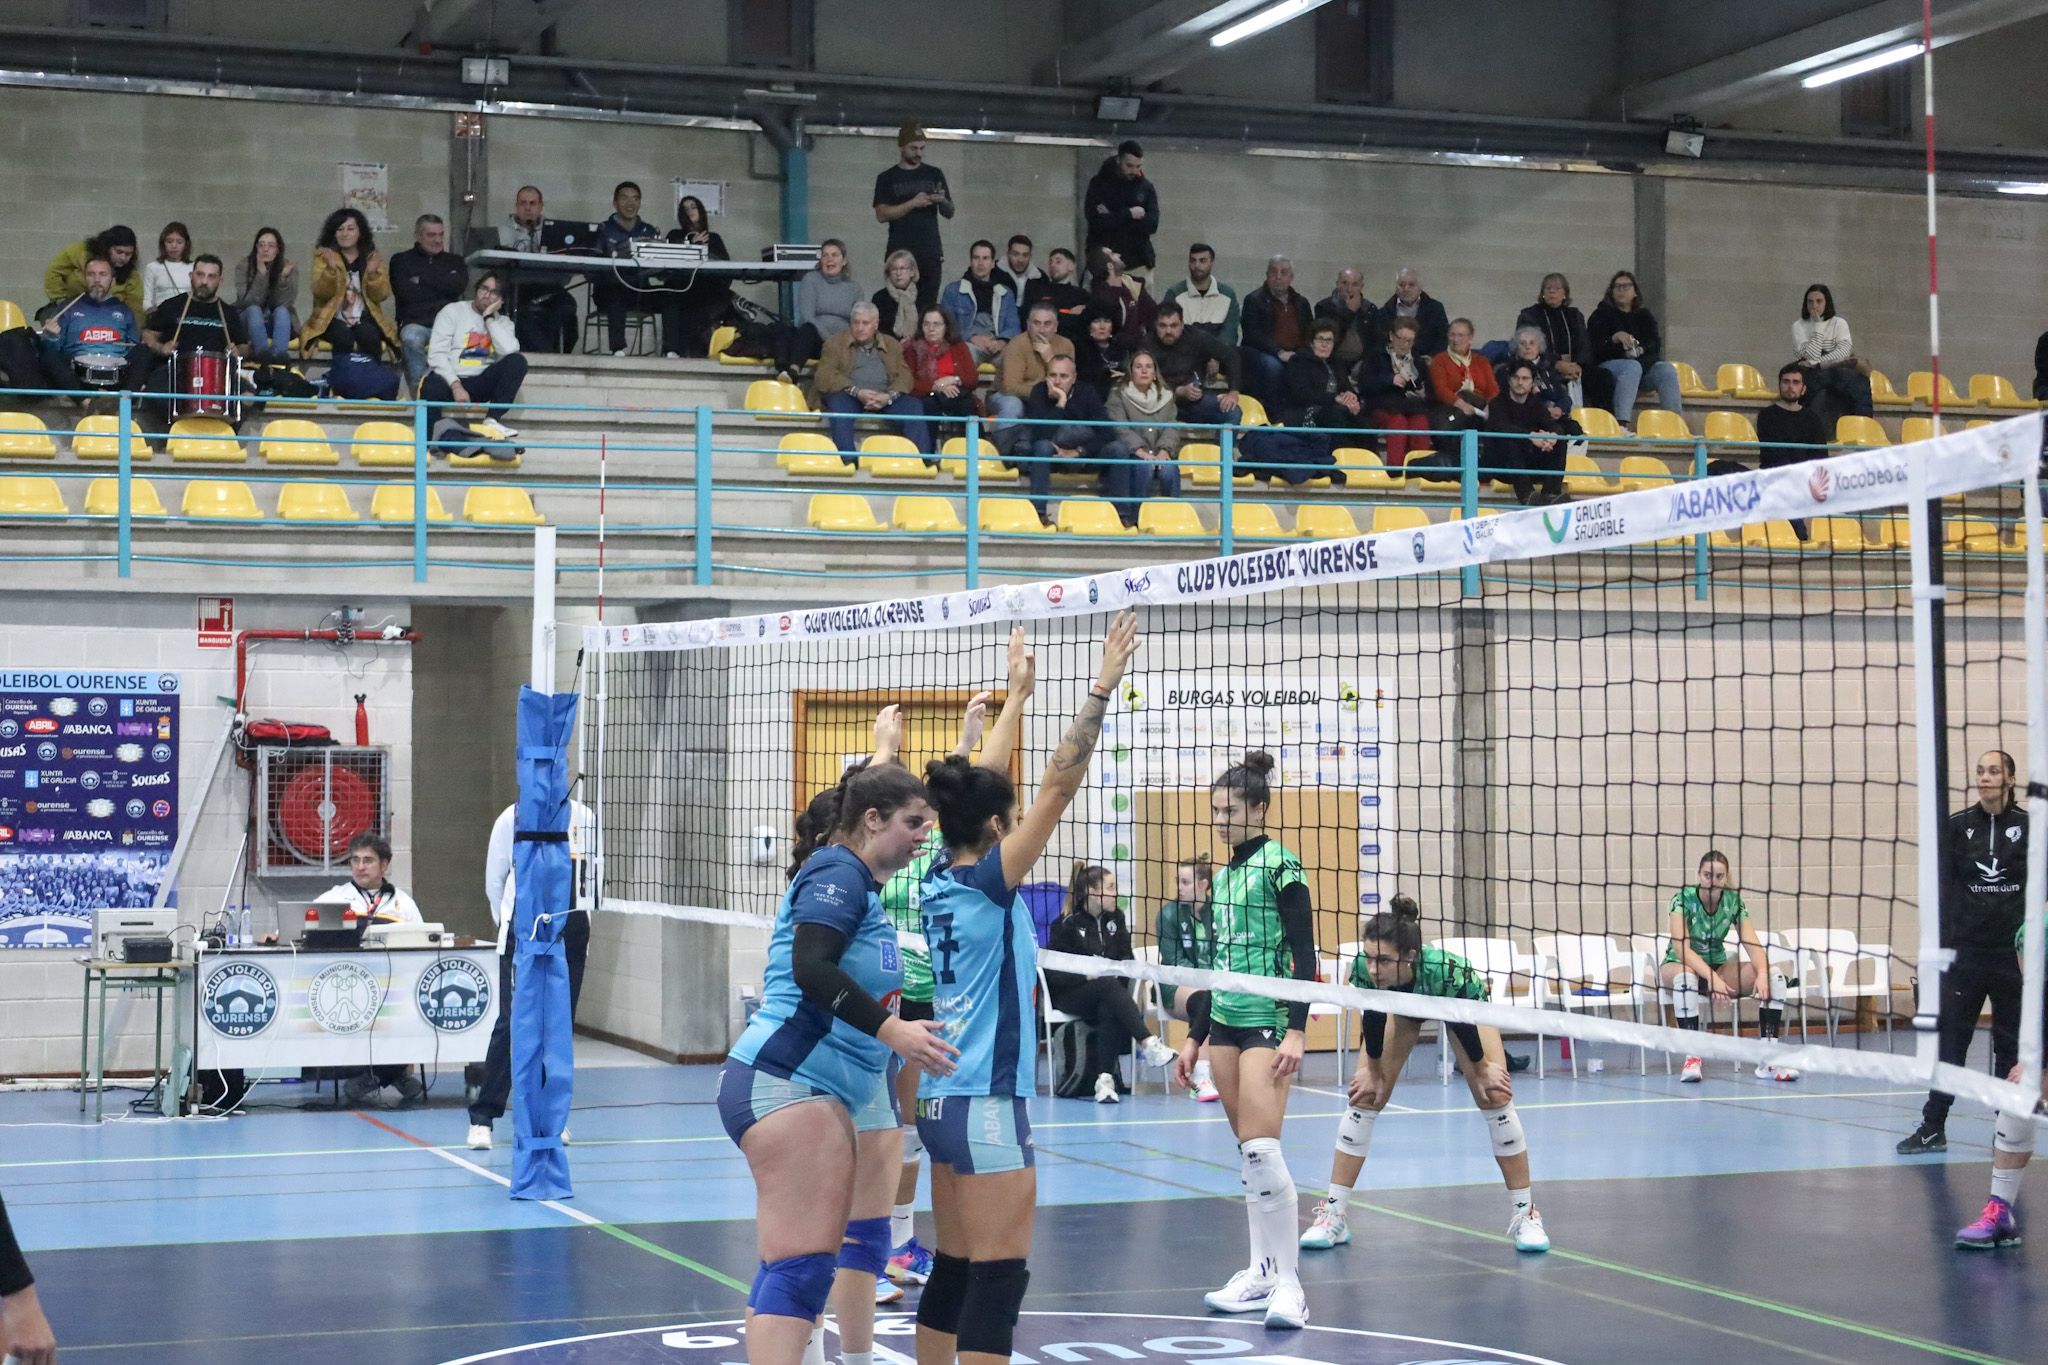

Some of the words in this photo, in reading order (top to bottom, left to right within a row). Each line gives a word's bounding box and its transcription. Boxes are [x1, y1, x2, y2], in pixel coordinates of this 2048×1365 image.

[84, 330, 117, 341] ABRIL
[1835, 468, 1893, 490] Xacobeo
[1576, 502, 1612, 522] GALICIA
[1576, 518, 1624, 541] SAUDABLE
[1178, 563, 1215, 594] CLUB
[1217, 549, 1295, 588] VOLEIBOL
[1299, 540, 1378, 577] OURENSE
[0, 674, 62, 689] LEIBOL
[66, 674, 148, 690] OURENSE
[1168, 690, 1234, 705] BURGAS
[1241, 690, 1320, 705] VOLEIBOL
[29, 720, 56, 730] ABRIL
[132, 772, 170, 787] SOUSAS
[319, 964, 358, 980] MUNICIPAL
[360, 970, 370, 980] DE
[421, 965, 442, 992] CLUB
[441, 960, 487, 992] VOLEIBOL
[208, 970, 228, 998] CLUB
[227, 965, 275, 997] VOLEIBOL
[310, 980, 325, 1022] CONSELLO
[364, 980, 378, 1021] DEPORTES
[212, 1013, 268, 1024] OURENSE
[427, 1006, 480, 1018] OURENSE
[228, 1025, 254, 1035] 1989
[442, 1020, 467, 1029] 1989
